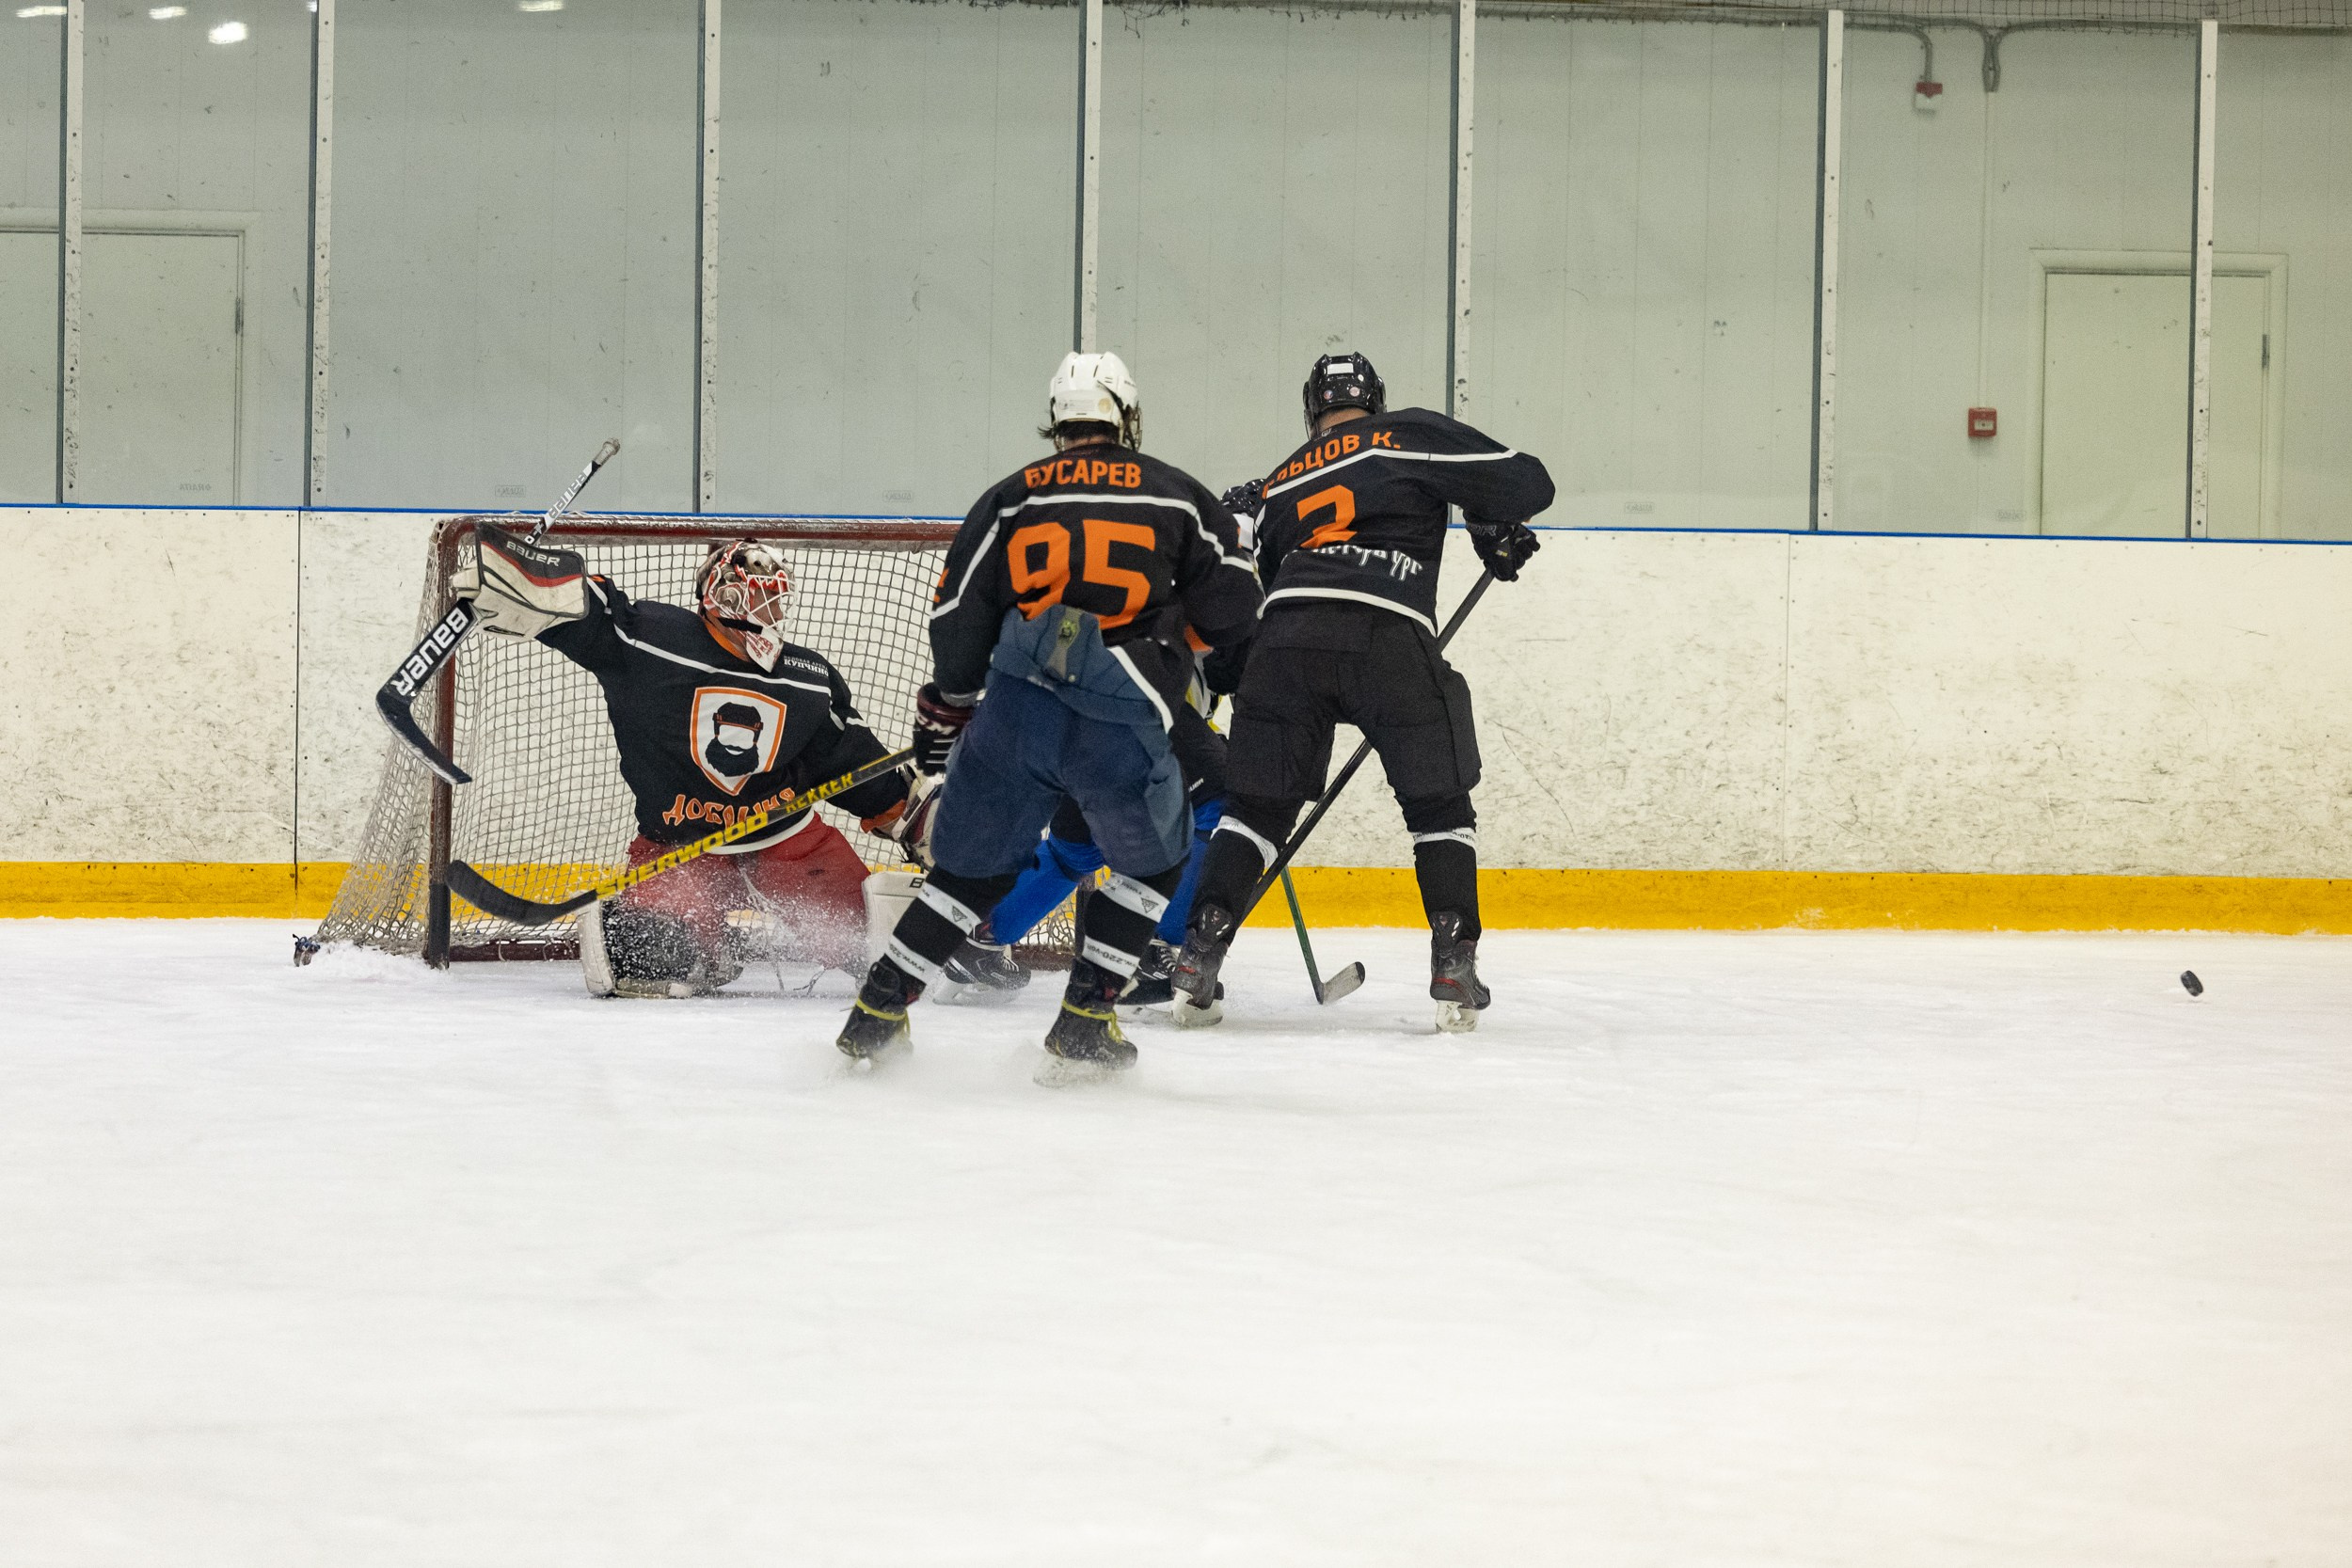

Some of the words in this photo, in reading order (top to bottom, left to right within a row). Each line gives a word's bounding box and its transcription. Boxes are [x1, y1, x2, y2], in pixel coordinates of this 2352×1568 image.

[506, 541, 561, 567] BAUER
[1296, 484, 1358, 547] 2
[1008, 519, 1155, 629] 95
[389, 608, 469, 696] BAUER
[596, 812, 769, 900] SHERWOOD
